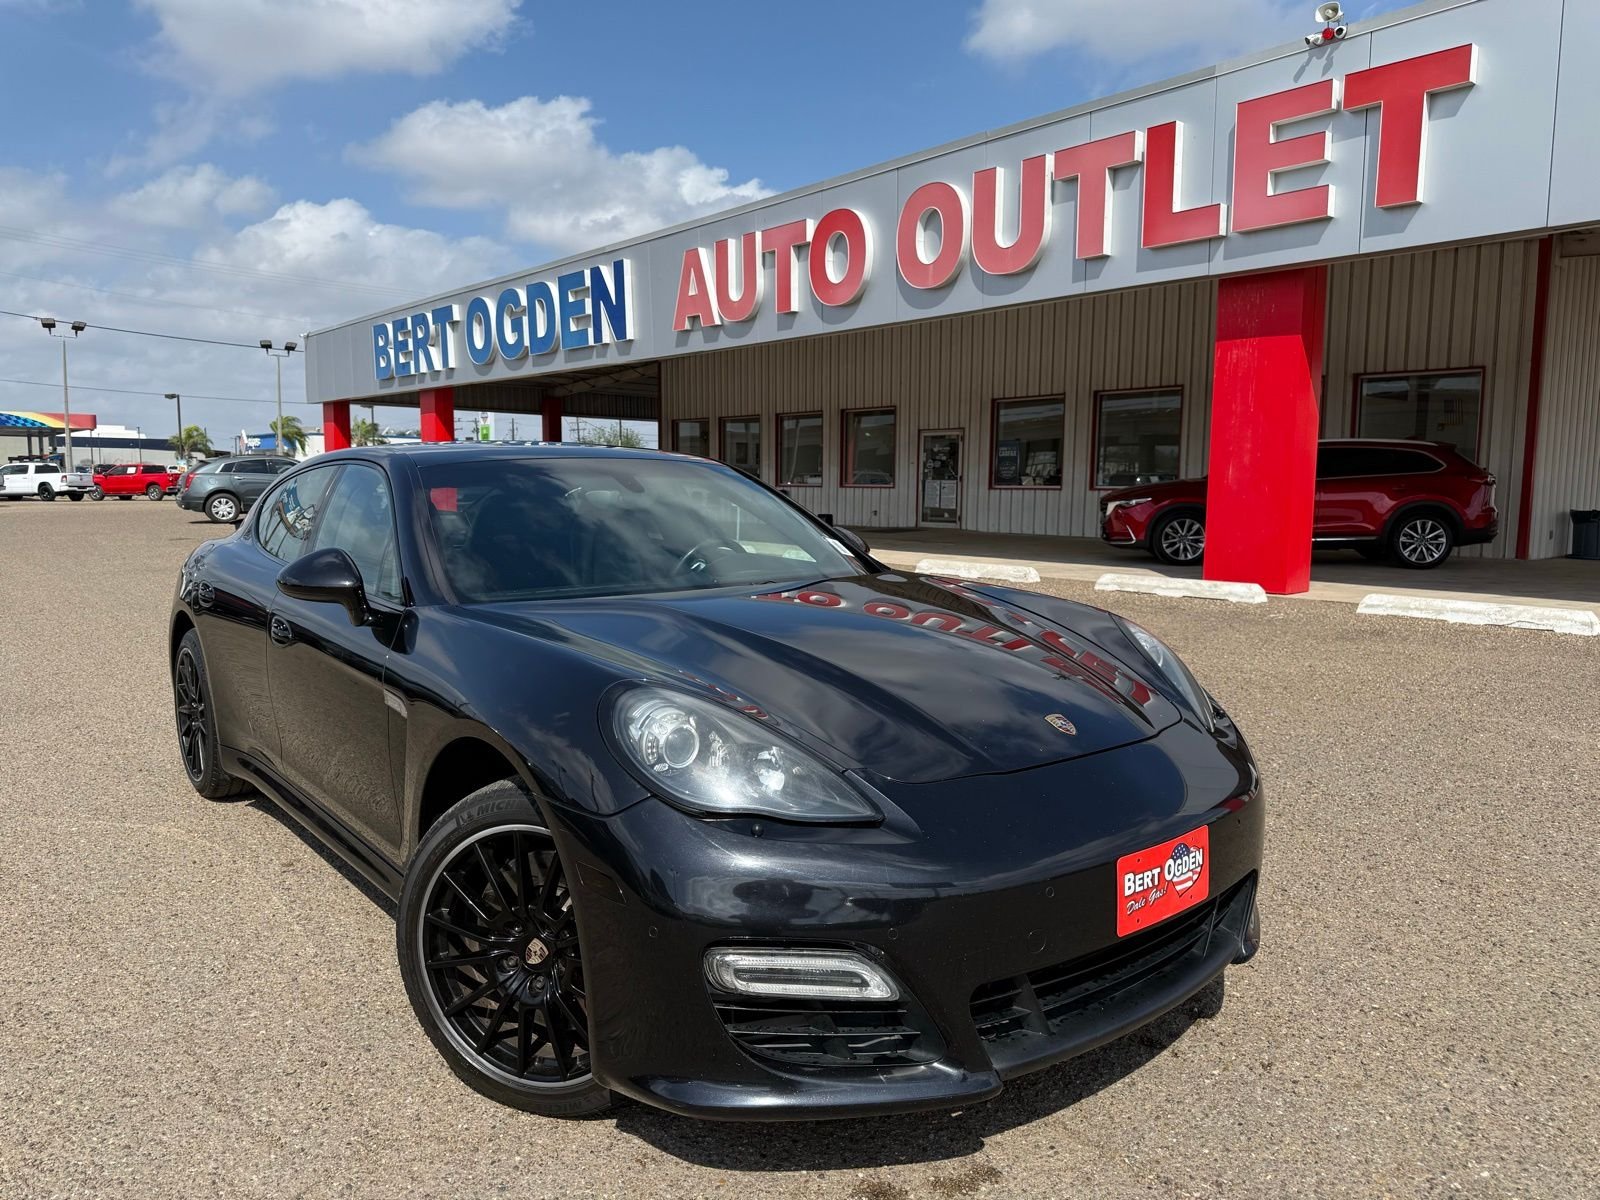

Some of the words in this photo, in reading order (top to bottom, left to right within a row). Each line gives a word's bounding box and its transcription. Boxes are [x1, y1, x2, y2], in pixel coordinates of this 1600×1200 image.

[372, 304, 460, 380] BERT
[465, 258, 633, 364] OGDEN
[672, 208, 874, 331] AUTO
[896, 43, 1478, 289] OUTLET
[1124, 867, 1161, 897] BERT
[1164, 848, 1203, 881] OGDEN
[1126, 897, 1146, 915] Dale
[1148, 881, 1168, 906] Gas!
